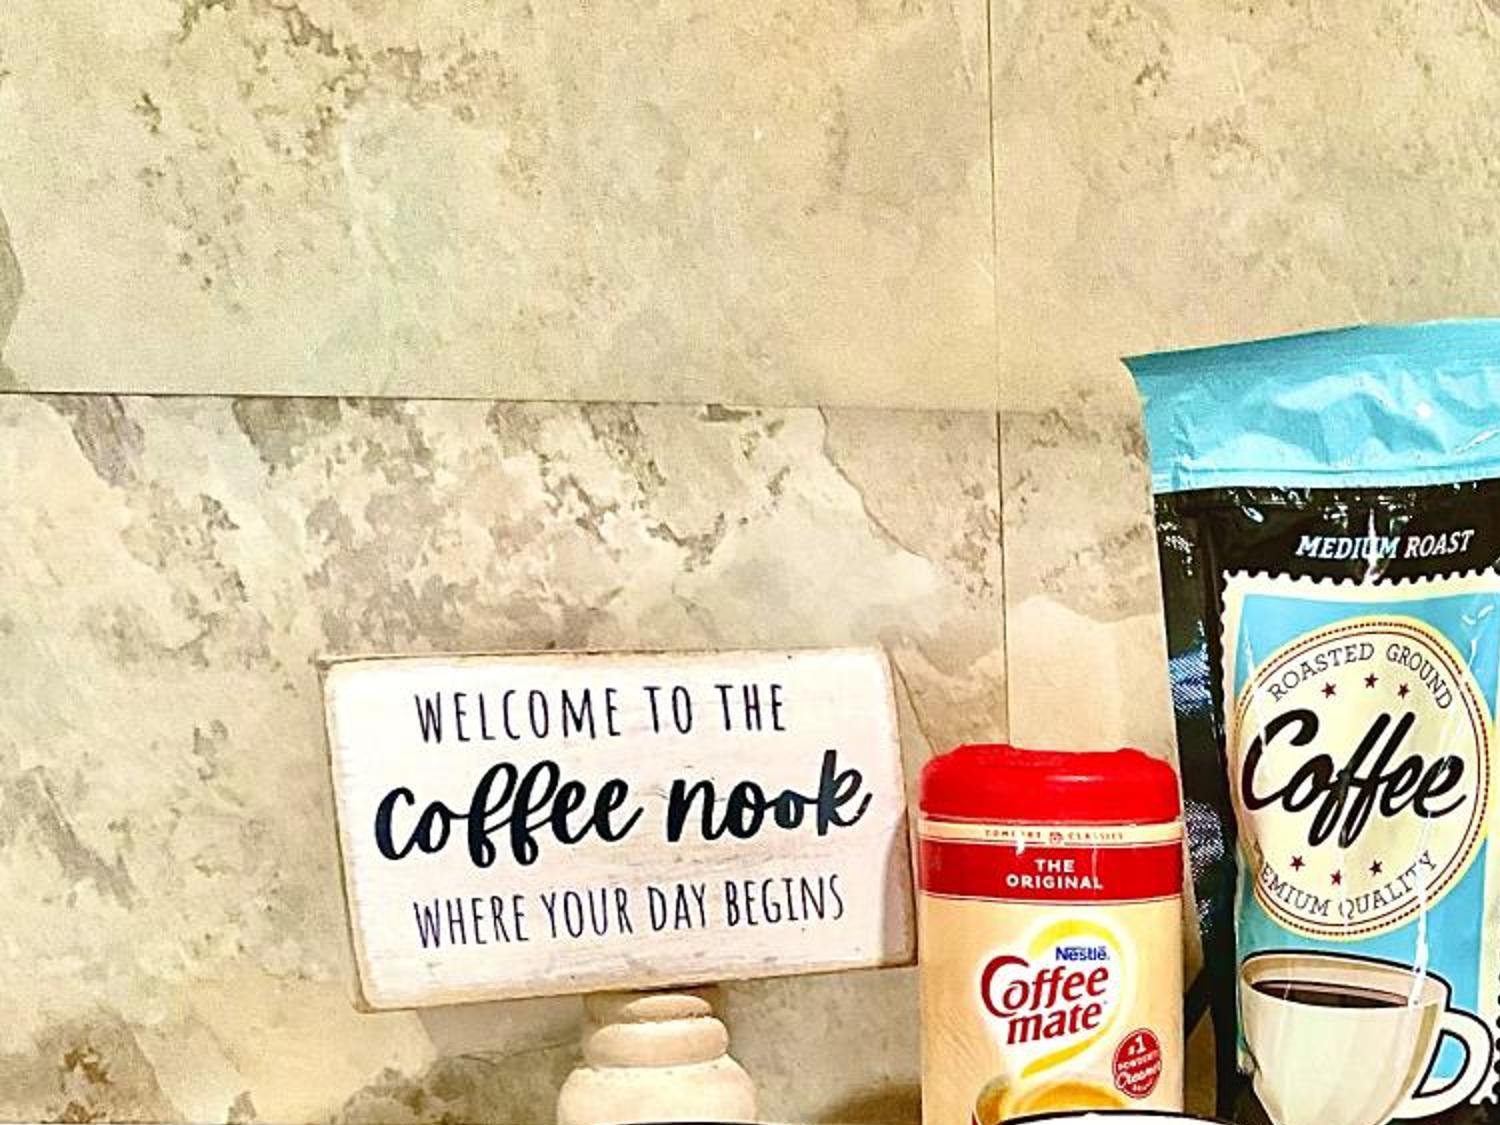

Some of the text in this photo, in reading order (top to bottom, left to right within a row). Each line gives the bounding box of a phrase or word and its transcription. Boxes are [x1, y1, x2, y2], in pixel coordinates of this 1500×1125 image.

[1296, 529, 1475, 559] MEDIUM ROAST
[1267, 642, 1453, 709] ROASTED GROUND
[415, 683, 786, 744] WELCOME TO THE
[374, 749, 873, 868] coffee nook
[1241, 708, 1466, 849] Coffee
[1005, 874, 1103, 890] ORIGINAL
[1034, 859, 1076, 873] THE
[1256, 848, 1437, 919] EMIUM QUALITY
[413, 873, 845, 949] WHERE YOUR DAY BEGINS
[981, 955, 1109, 1018] Coffee
[1006, 1002, 1103, 1045] mate
